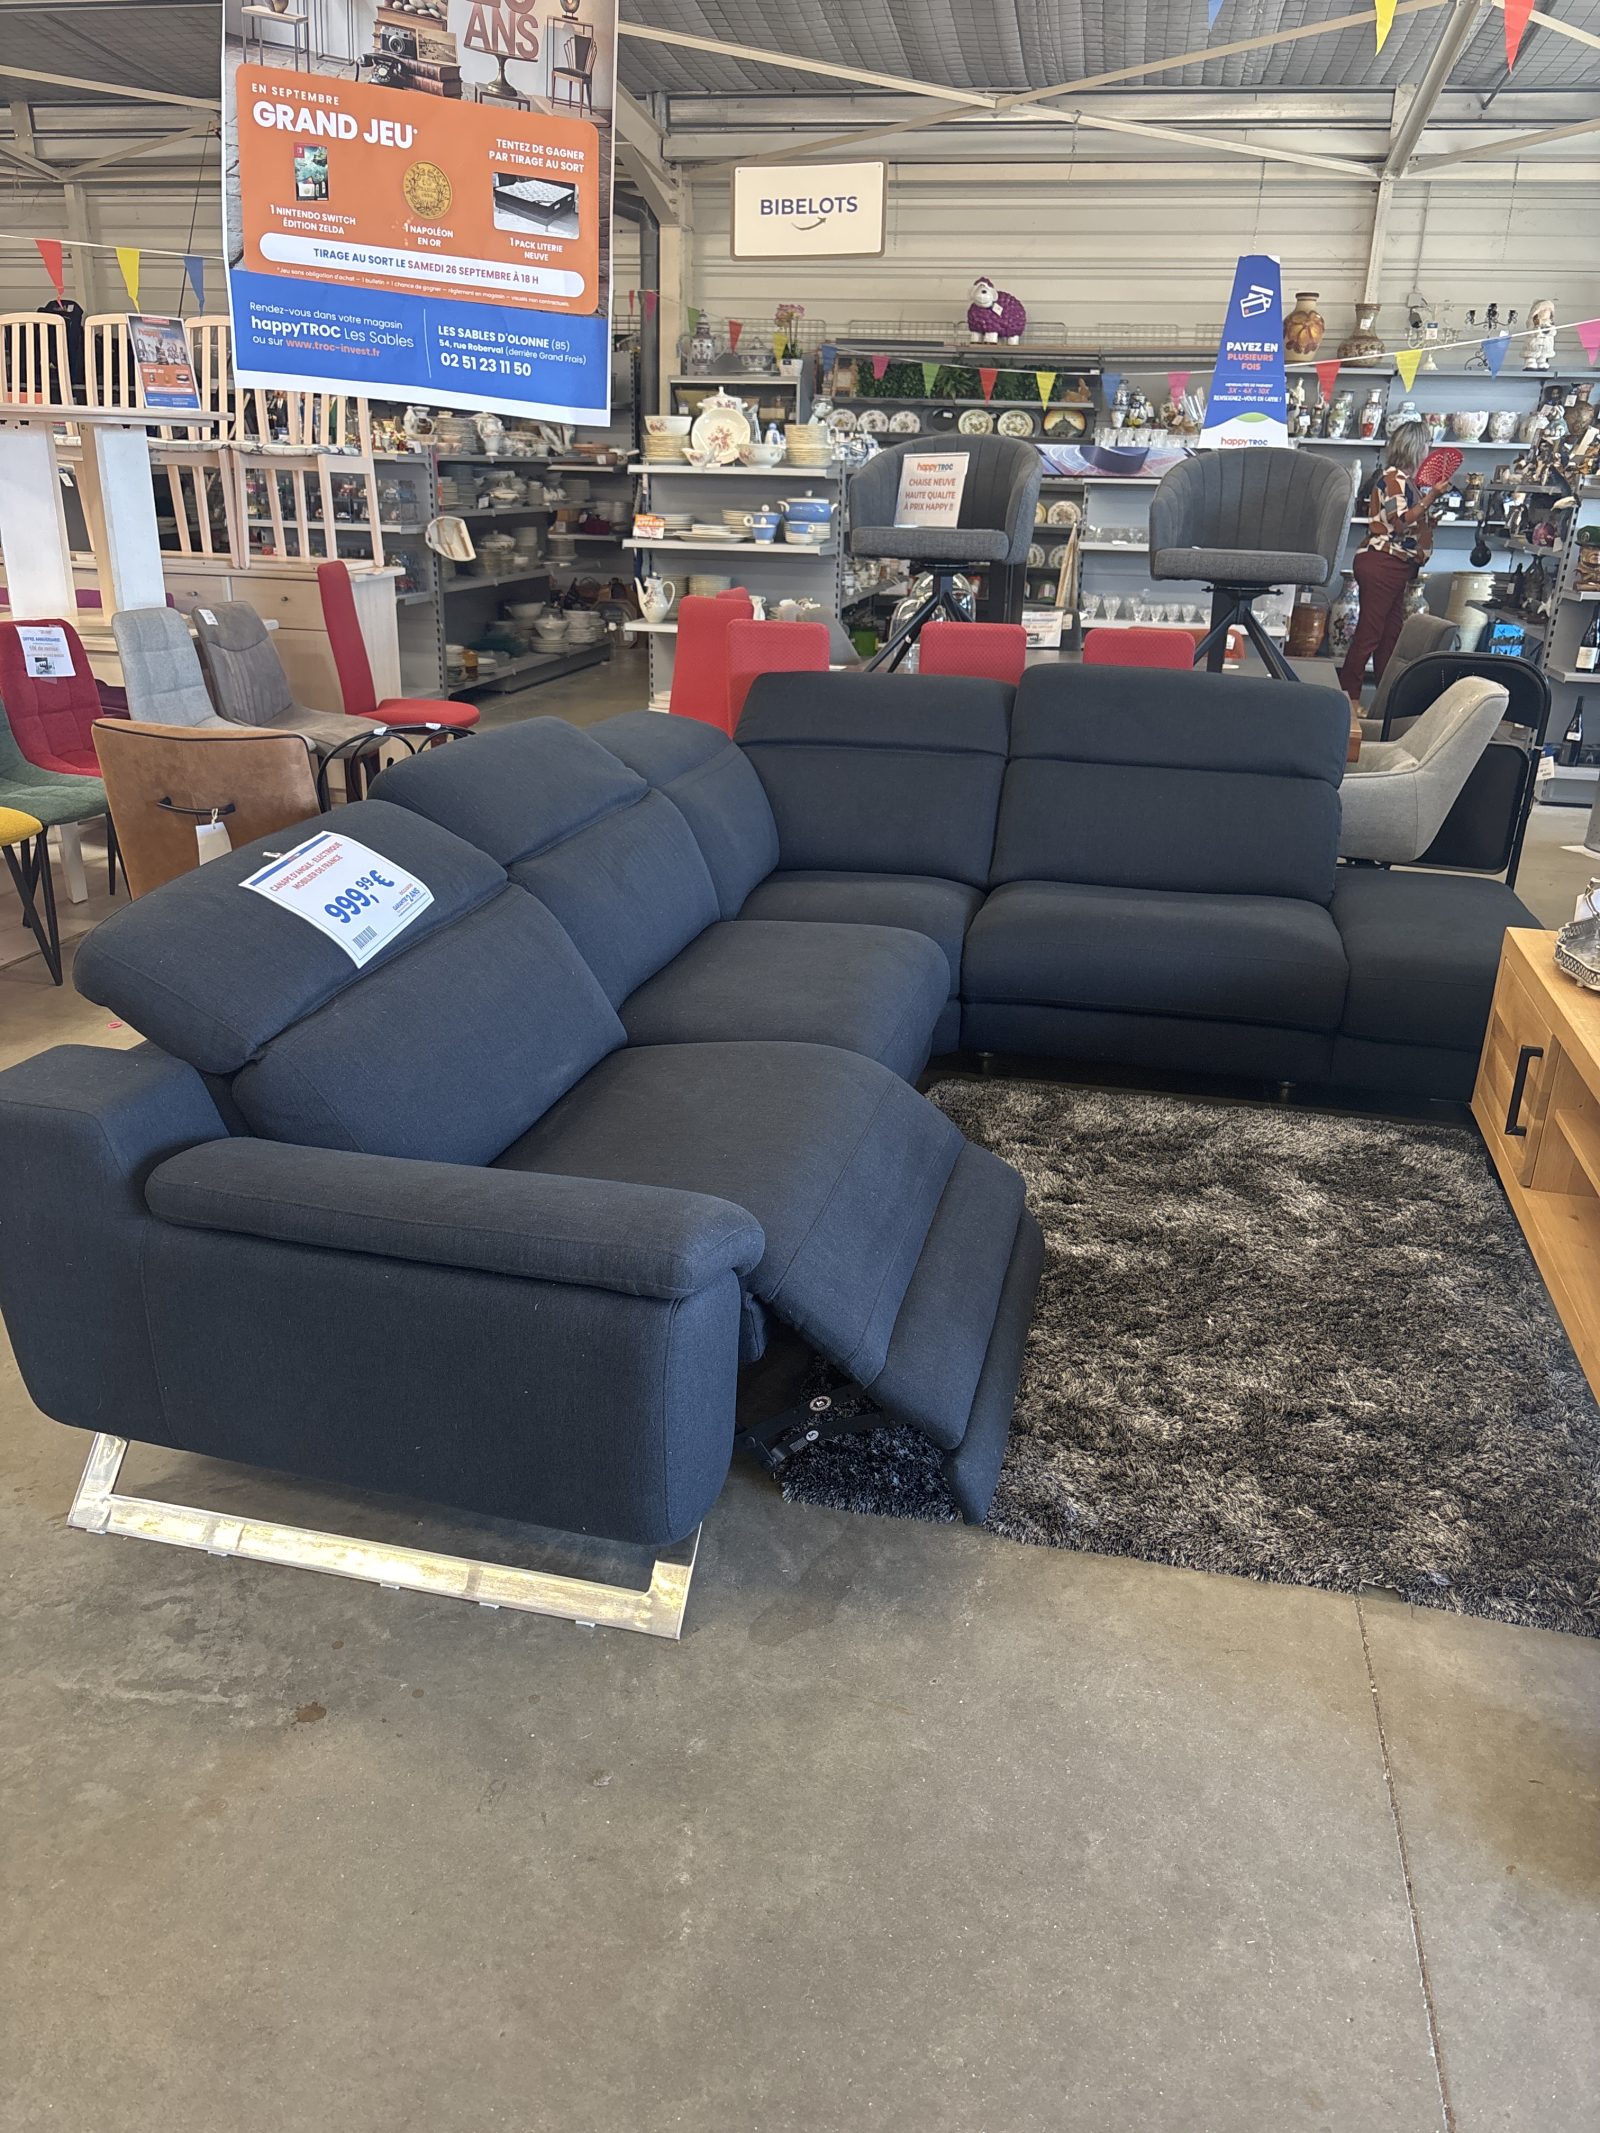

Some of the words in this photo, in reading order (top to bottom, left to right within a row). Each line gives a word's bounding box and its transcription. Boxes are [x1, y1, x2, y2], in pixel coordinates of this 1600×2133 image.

[464, 3, 540, 59] ANS
[251, 83, 267, 95] EN
[272, 86, 340, 106] SEPTEMBRE
[253, 100, 358, 140] GRAND
[496, 139, 530, 153] TENTEZ
[532, 144, 544, 155] DE
[546, 145, 585, 161] GAGNER
[488, 151, 508, 162] PAR
[510, 153, 544, 167] TIRAGE
[545, 158, 559, 169] AU
[560, 161, 585, 173] SORT
[270, 204, 275, 215] 1
[276, 207, 321, 220] NINTENDO
[321, 213, 357, 225] SWITCH
[760, 196, 858, 215] BIBELOTS
[283, 217, 317, 231] ÉDITION
[318, 224, 345, 235] ZELDA
[404, 222, 409, 233] 1
[410, 224, 454, 238] NAPOLÉON
[417, 237, 429, 246] EN
[430, 238, 442, 247] OR
[510, 237, 515, 247] 1
[515, 239, 536, 250] PACK
[536, 241, 564, 253] LITERIE
[313, 248, 350, 261] TIRAGE
[351, 252, 366, 263] AU
[368, 255, 393, 267] SORT
[395, 259, 406, 268] LE
[407, 260, 444, 273] SAMEDI
[445, 264, 457, 274] 26
[459, 266, 511, 281] SEPTEMBRE
[513, 270, 520, 282] À
[521, 274, 530, 283] 18
[532, 275, 539, 284] H
[524, 251, 549, 262] NEUVE
[305, 270, 334, 279] obligation
[335, 273, 356, 281] d'achat
[394, 281, 415, 289] chance
[250, 301, 312, 319] Rendez-vous
[313, 310, 337, 321] dans
[338, 314, 362, 324] votre
[363, 318, 403, 330] magasin
[251, 315, 342, 338] happyTROC
[344, 327, 366, 342] Les
[369, 331, 415, 348] Sables
[437, 325, 456, 337] LES
[457, 327, 496, 342] SABLES
[498, 333, 550, 349] D'OLONNE
[551, 338, 570, 352] (85)
[252, 335, 266, 344] ou
[268, 337, 284, 347] sur
[286, 338, 381, 357] www.troc-invest.fr
[439, 339, 452, 348] 54,
[453, 342, 467, 350] rue
[467, 342, 504, 355] Roberval
[505, 346, 538, 359] (derrière
[539, 351, 564, 362] Grand
[564, 354, 587, 366] Frais)
[1226, 342, 1262, 352] PAYEZ
[1264, 343, 1279, 352] EN
[440, 352, 460, 368] 02
[462, 355, 477, 370] 51
[479, 358, 497, 372] 23
[499, 360, 511, 374] 11
[513, 362, 532, 377] 50
[1227, 353, 1274, 362] PLUSIEURS
[908, 478, 932, 487] CHAISE
[933, 478, 957, 486] NEUVE
[905, 491, 926, 499] HAUTE
[925, 503, 949, 511] HAPPY
[312, 842, 343, 863] ELECTRIQUE
[292, 871, 315, 890] MOBILIER
[321, 854, 343, 871] FRANCE
